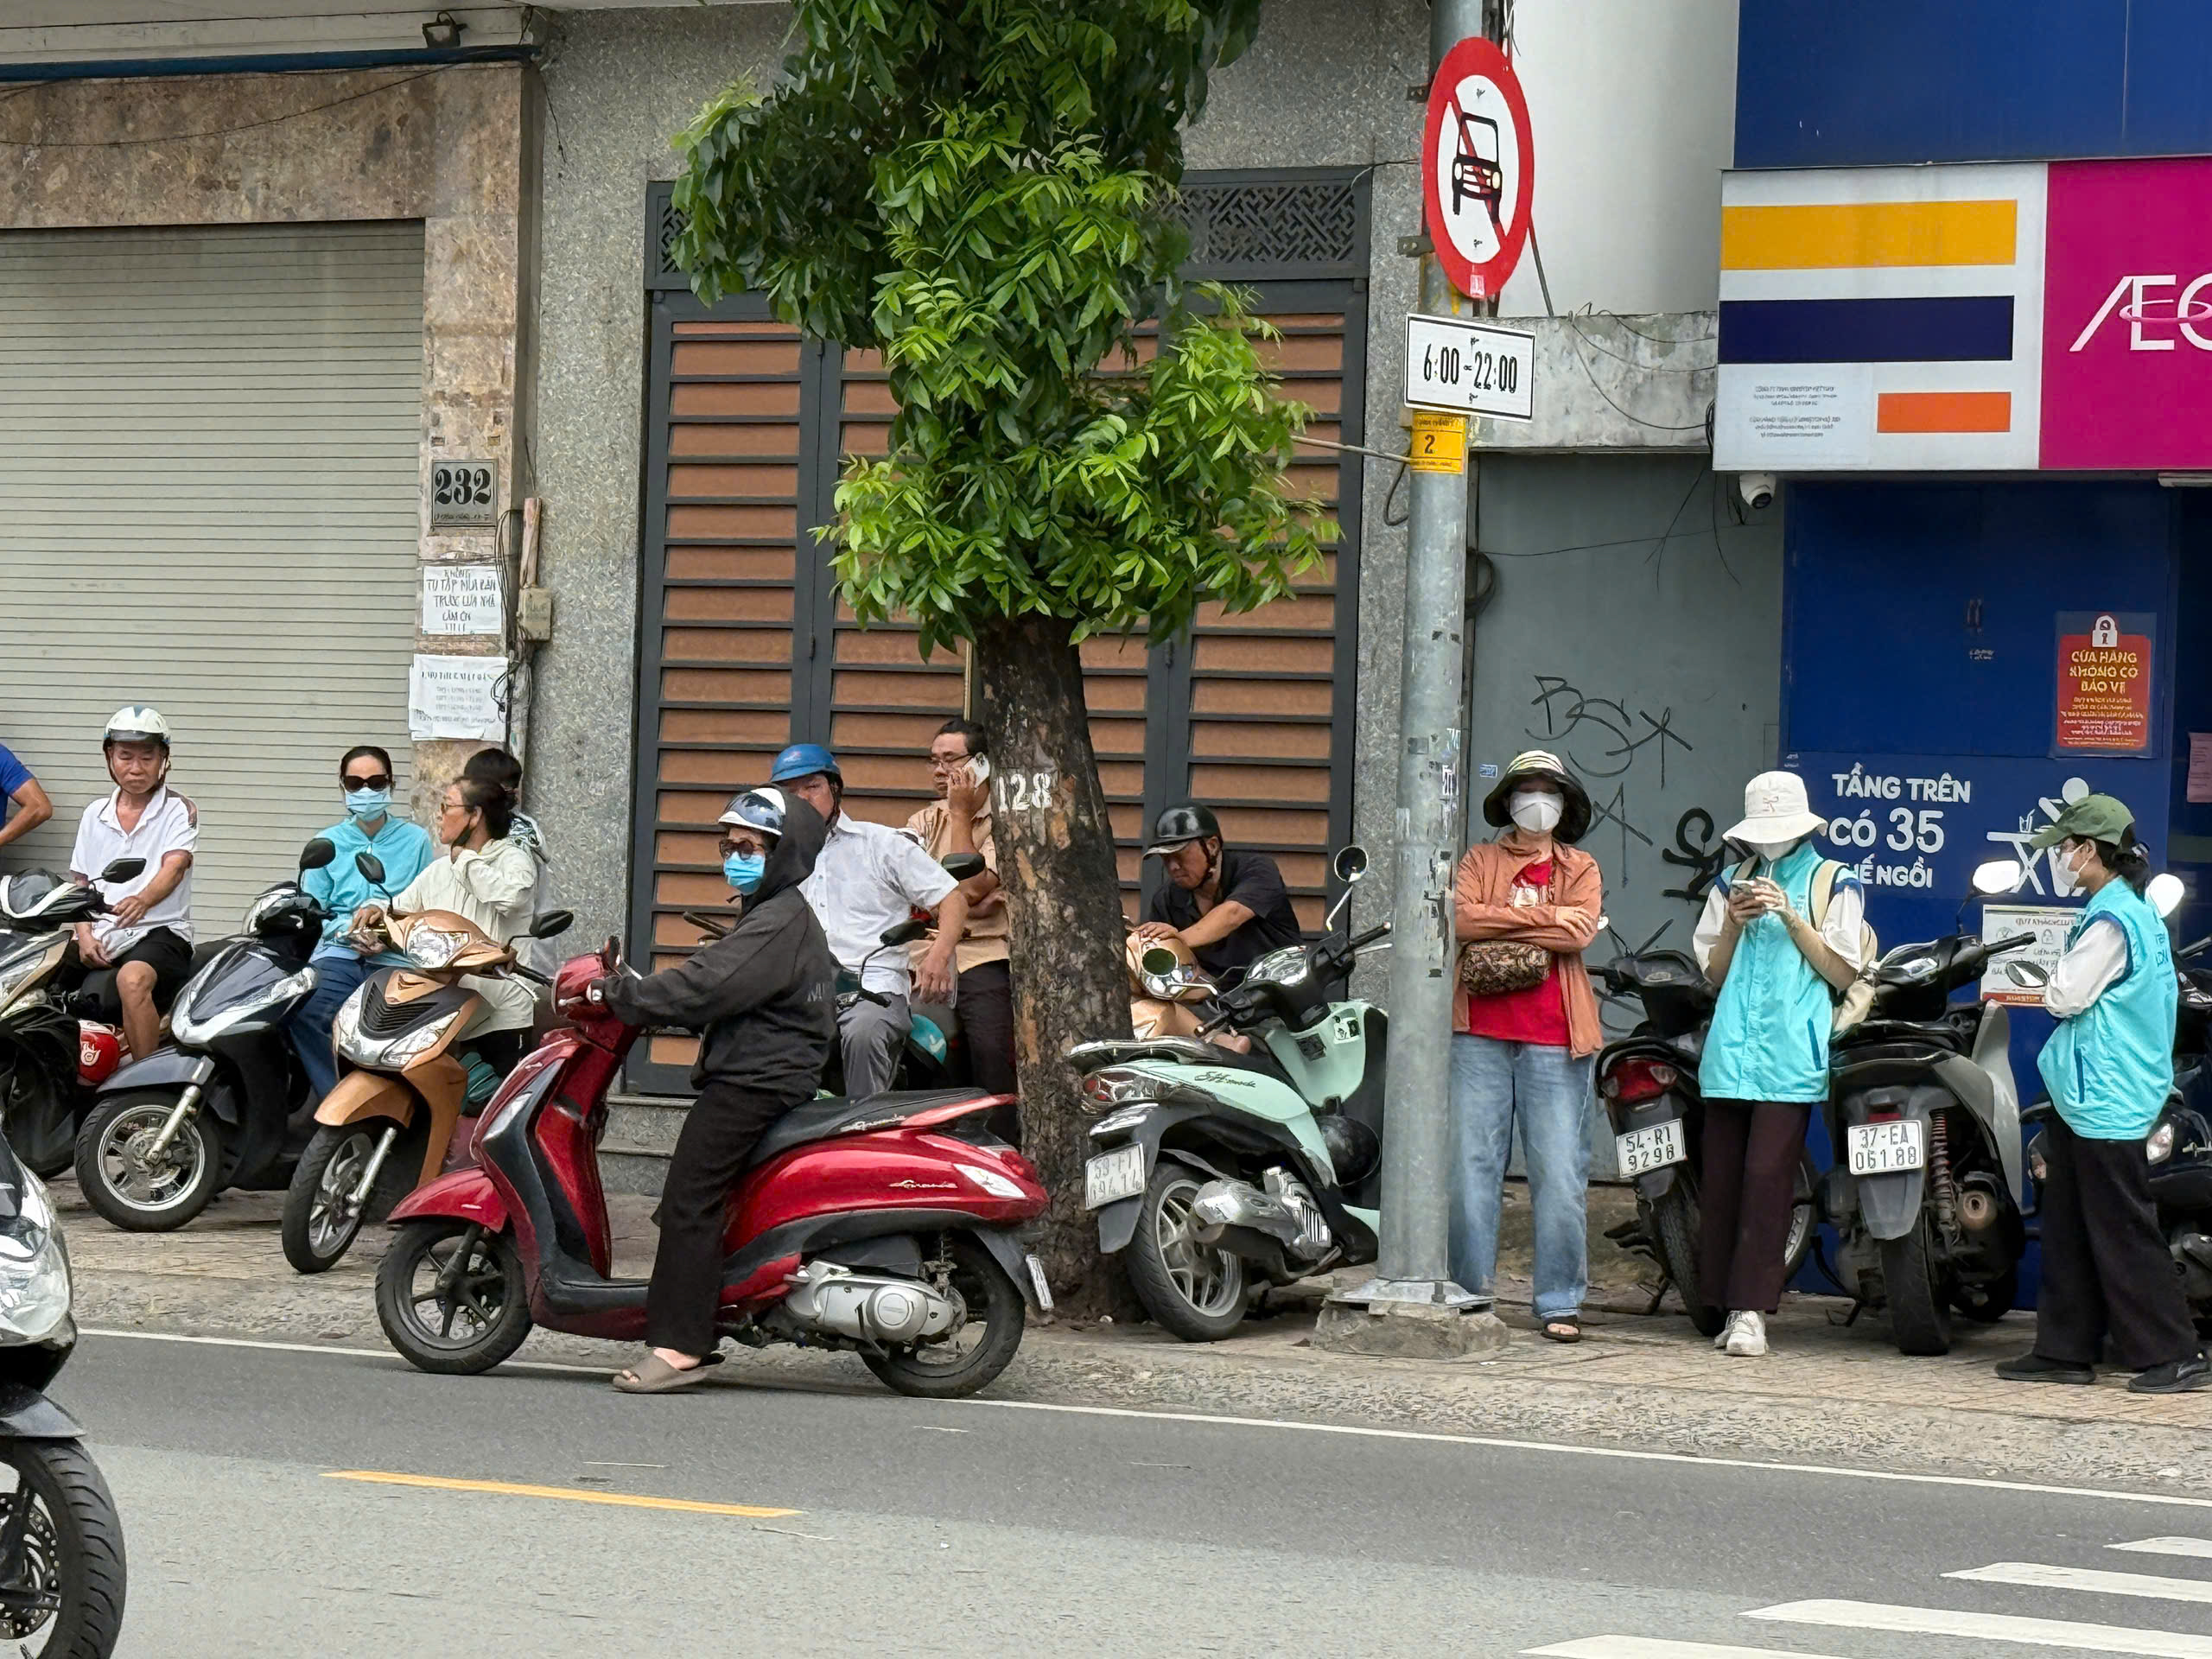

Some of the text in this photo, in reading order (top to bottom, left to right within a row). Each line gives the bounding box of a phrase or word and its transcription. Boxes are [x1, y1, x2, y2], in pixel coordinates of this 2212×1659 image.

[1424, 434, 1436, 454] 2
[435, 468, 492, 505] 232
[998, 772, 1053, 810] 128
[1832, 761, 1971, 803] TẦNG TRÊN
[1828, 807, 1944, 854] CÓ 35
[1876, 855, 1933, 888] NGỒI
